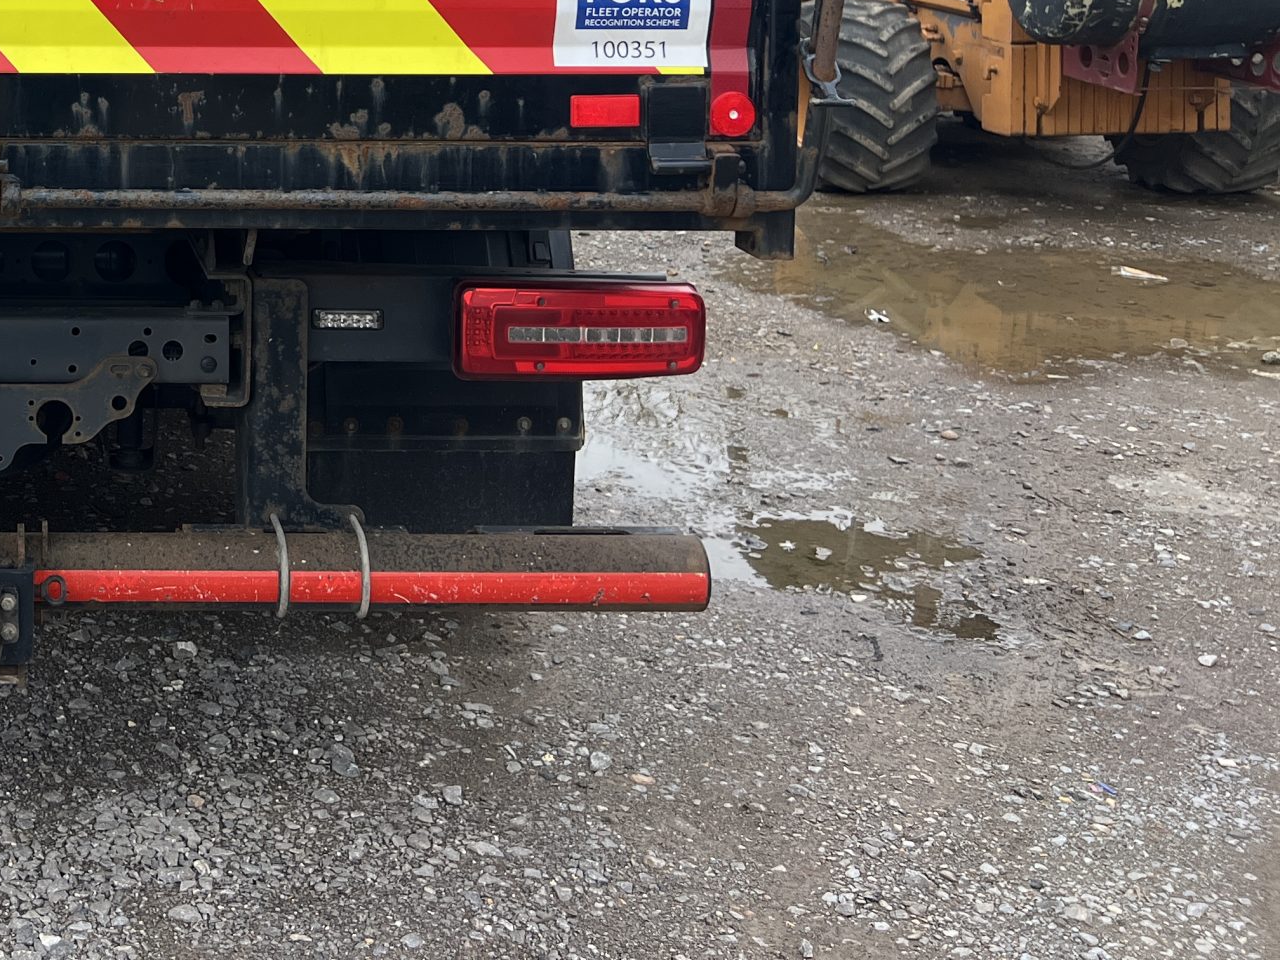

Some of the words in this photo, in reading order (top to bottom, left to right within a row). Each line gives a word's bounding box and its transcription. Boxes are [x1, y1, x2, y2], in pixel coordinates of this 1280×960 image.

[586, 7, 619, 17] FLEET
[621, 7, 681, 17] OPERATOR
[585, 19, 644, 27] RECOGNITION
[646, 19, 680, 27] SCHEME
[591, 40, 667, 58] 100351
